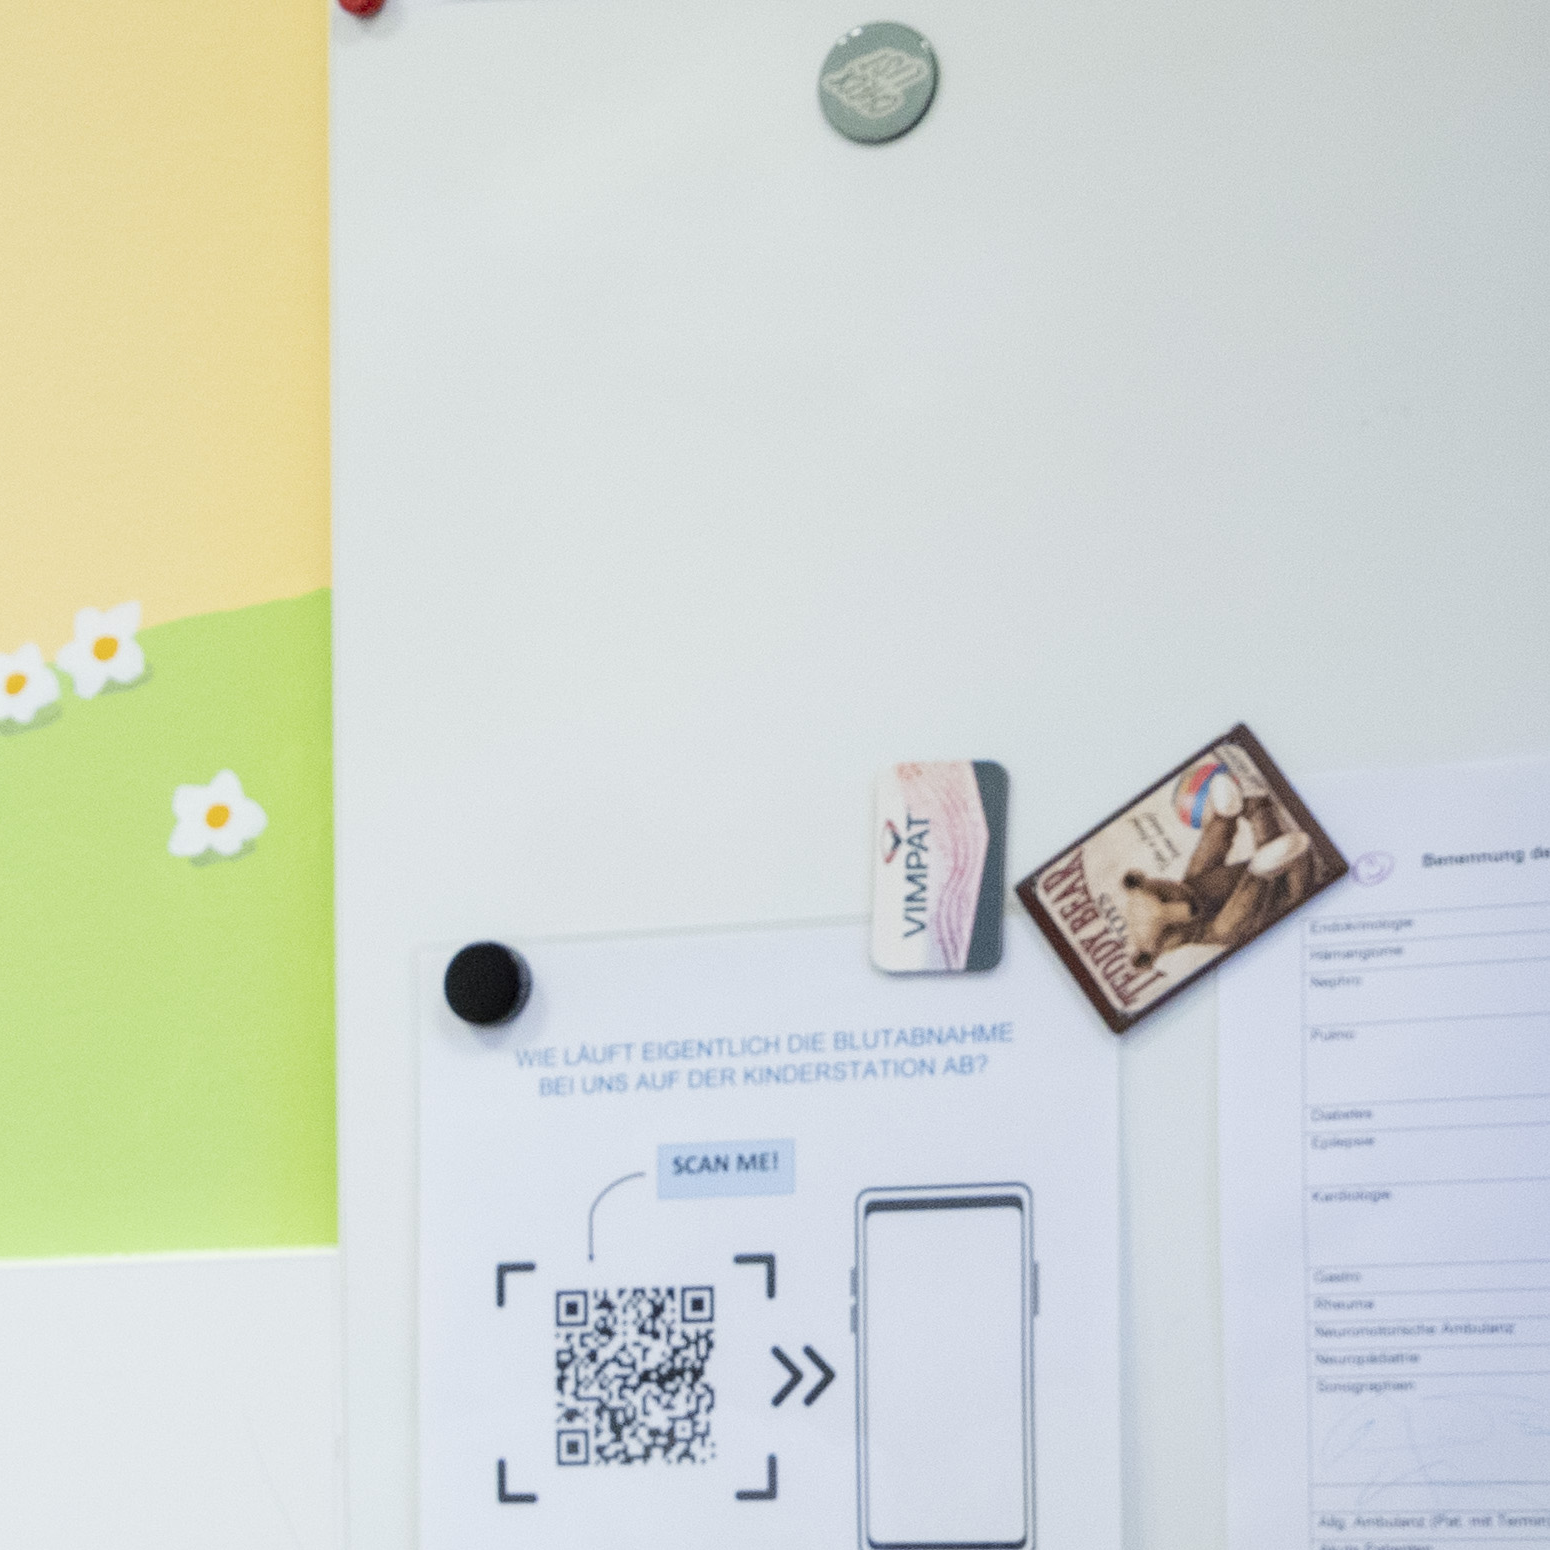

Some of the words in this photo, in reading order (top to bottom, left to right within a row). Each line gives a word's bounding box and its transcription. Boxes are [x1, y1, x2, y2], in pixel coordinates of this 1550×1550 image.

[903, 810, 930, 939] VIMPAT
[1042, 848, 1100, 935] BEAR
[1079, 927, 1167, 1007] TEDDY
[515, 1047, 557, 1068] WIE
[563, 1041, 634, 1067] LÄUFT
[641, 1034, 781, 1062] EIGENTLICH
[787, 1032, 826, 1053] DIE
[832, 1021, 1015, 1051] BLUTABNAHME
[539, 1075, 574, 1097] BEI
[581, 1072, 628, 1095] UNS
[635, 1070, 680, 1092] AUF
[687, 1067, 737, 1089] DER
[743, 1055, 936, 1087] KINDERSTATION
[942, 1053, 989, 1077] AB?
[672, 1153, 730, 1176] SCAN
[736, 1150, 779, 1173] ME!
